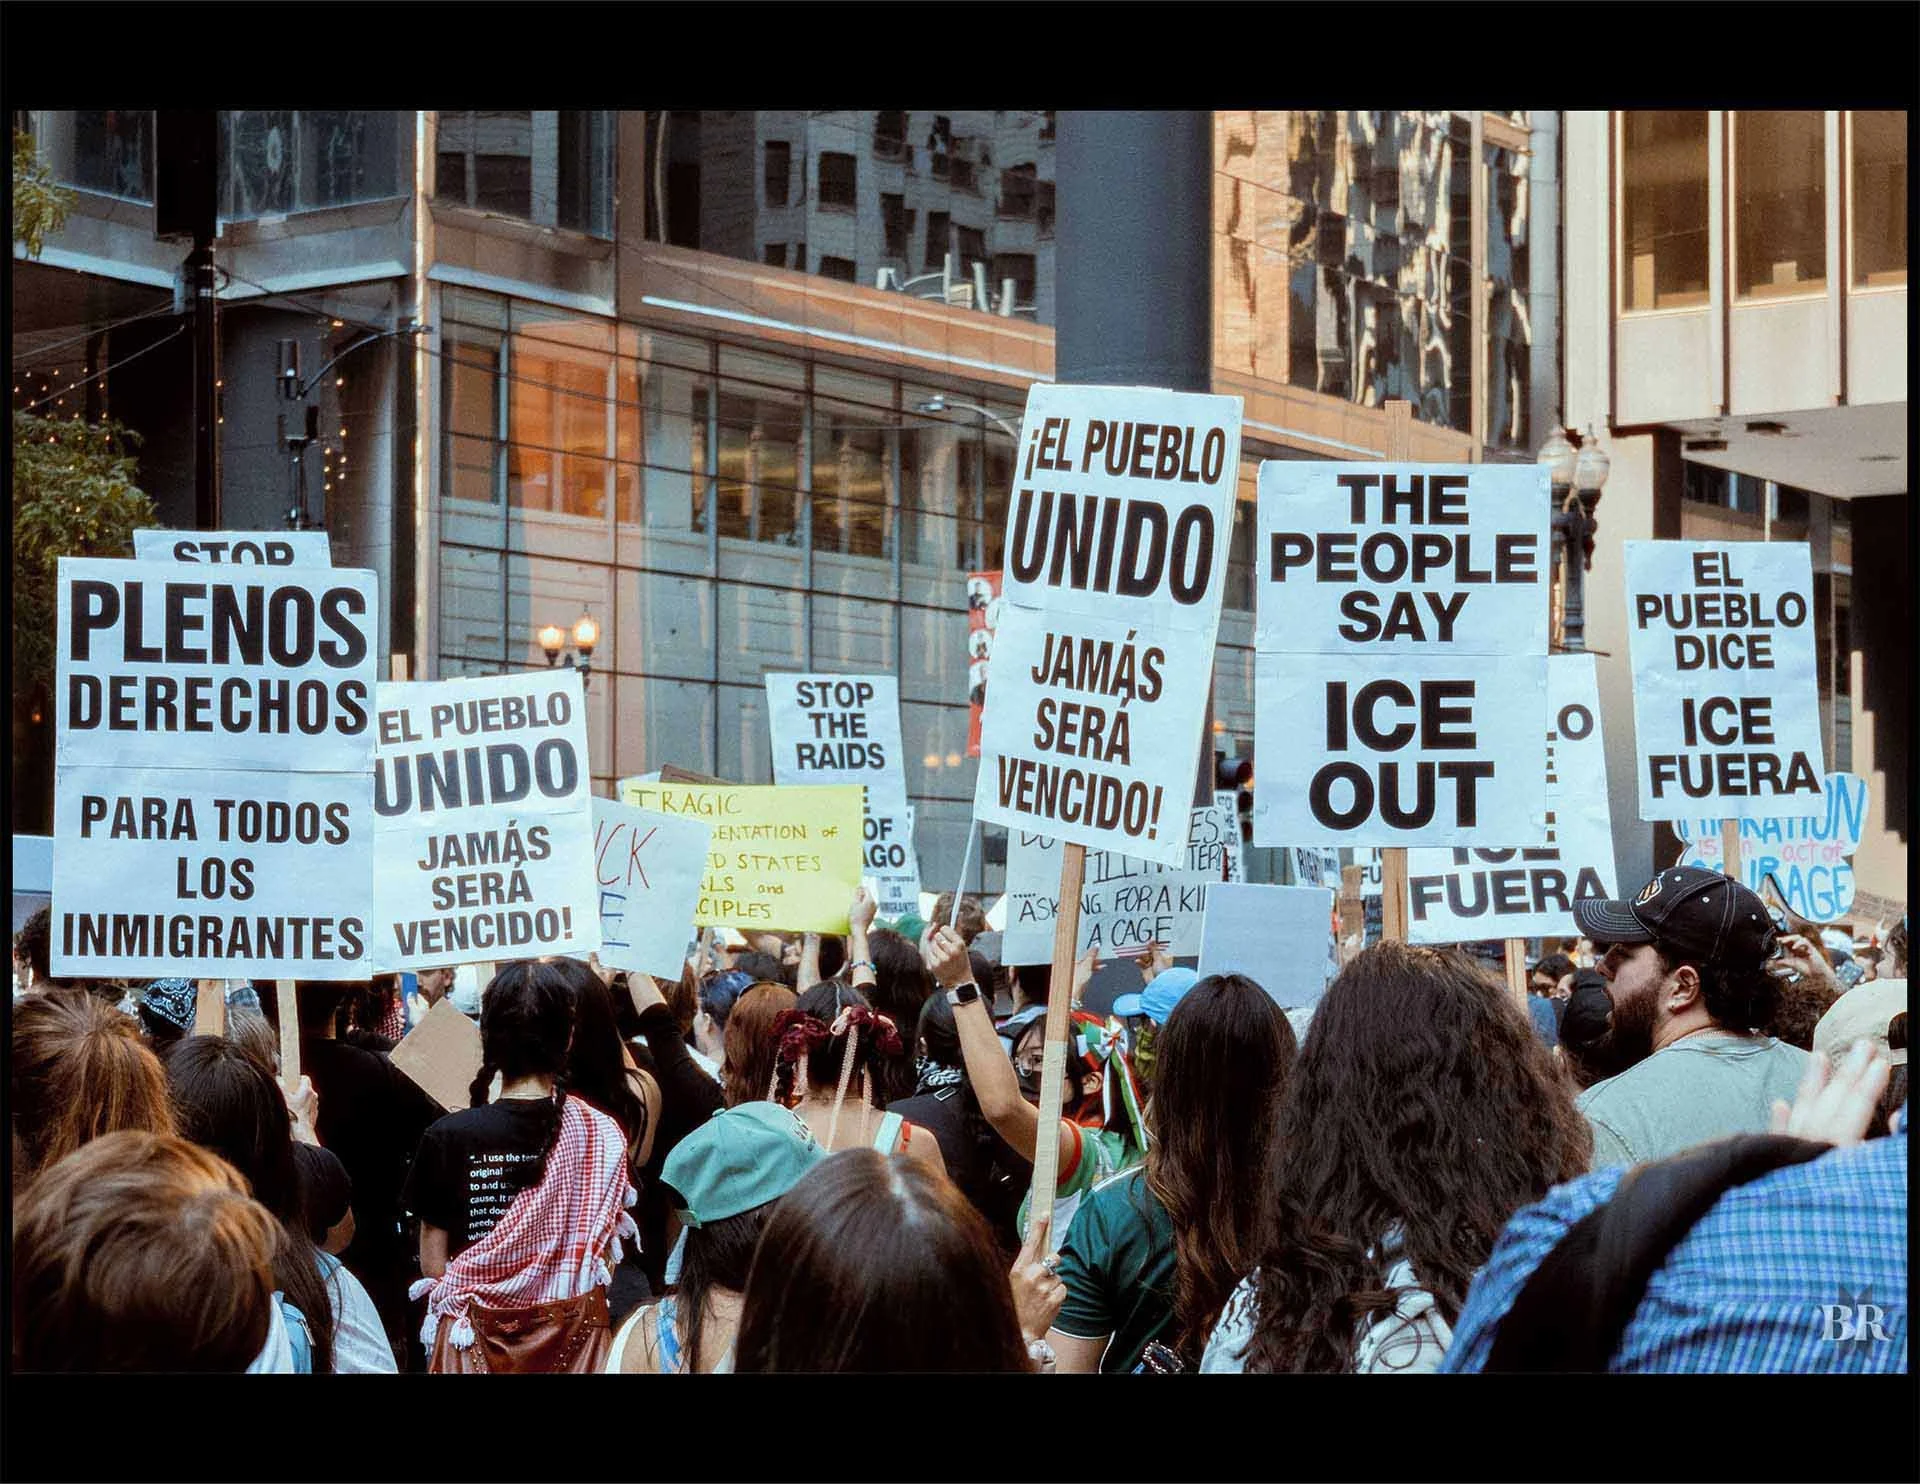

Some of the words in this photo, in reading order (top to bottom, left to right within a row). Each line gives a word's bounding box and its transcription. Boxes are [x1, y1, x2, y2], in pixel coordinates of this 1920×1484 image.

[1024, 417, 1072, 481] ¡EL
[1081, 420, 1226, 485] PUEBLO
[1337, 474, 1469, 525] THE
[173, 541, 294, 566] STOP
[1010, 489, 1215, 605] UNIDO
[1270, 532, 1538, 584] PEOPLE
[1693, 551, 1743, 588] EL
[70, 579, 368, 668] PLENOS
[1338, 590, 1470, 643] SAY
[1636, 592, 1807, 629] PUEBLO
[1031, 630, 1165, 701] JAMÁS
[1675, 633, 1775, 671] DICE
[69, 674, 368, 735] DERECHOS
[431, 691, 572, 739] PUEBLO
[796, 682, 874, 708] STOP
[1326, 680, 1476, 752] ICE
[808, 713, 868, 738] THE
[1034, 697, 1131, 766] SERÁ
[1682, 697, 1775, 747] ICE
[375, 738, 578, 816] UNIDO
[796, 743, 885, 770] RAIDS
[1648, 752, 1823, 799] FUERA
[631, 790, 742, 815] TRAGIC
[998, 754, 1164, 841] VENCIDO!
[1308, 761, 1495, 831] OUT
[80, 796, 198, 841] PARA
[213, 799, 350, 845] TODOS
[821, 825, 839, 838] of
[418, 820, 551, 871] JAMÁS
[737, 853, 822, 872] STATES
[177, 857, 255, 901] LOS
[431, 863, 534, 911] SERÁ
[1409, 867, 1610, 921] FUERA
[695, 898, 772, 919] CIPLES
[1018, 893, 1101, 923] ASKNG
[1114, 885, 1152, 913] FOR
[1153, 886, 1171, 913] A
[62, 912, 364, 960] INMIGRANTES
[393, 907, 572, 956] VENCIDO!
[1111, 915, 1174, 946] CAGE
[469, 1167, 503, 1178] original
[488, 1153, 504, 1163] use
[505, 1152, 520, 1162] the
[469, 1183, 480, 1191] to
[481, 1181, 498, 1190] and
[469, 1207, 487, 1217] that
